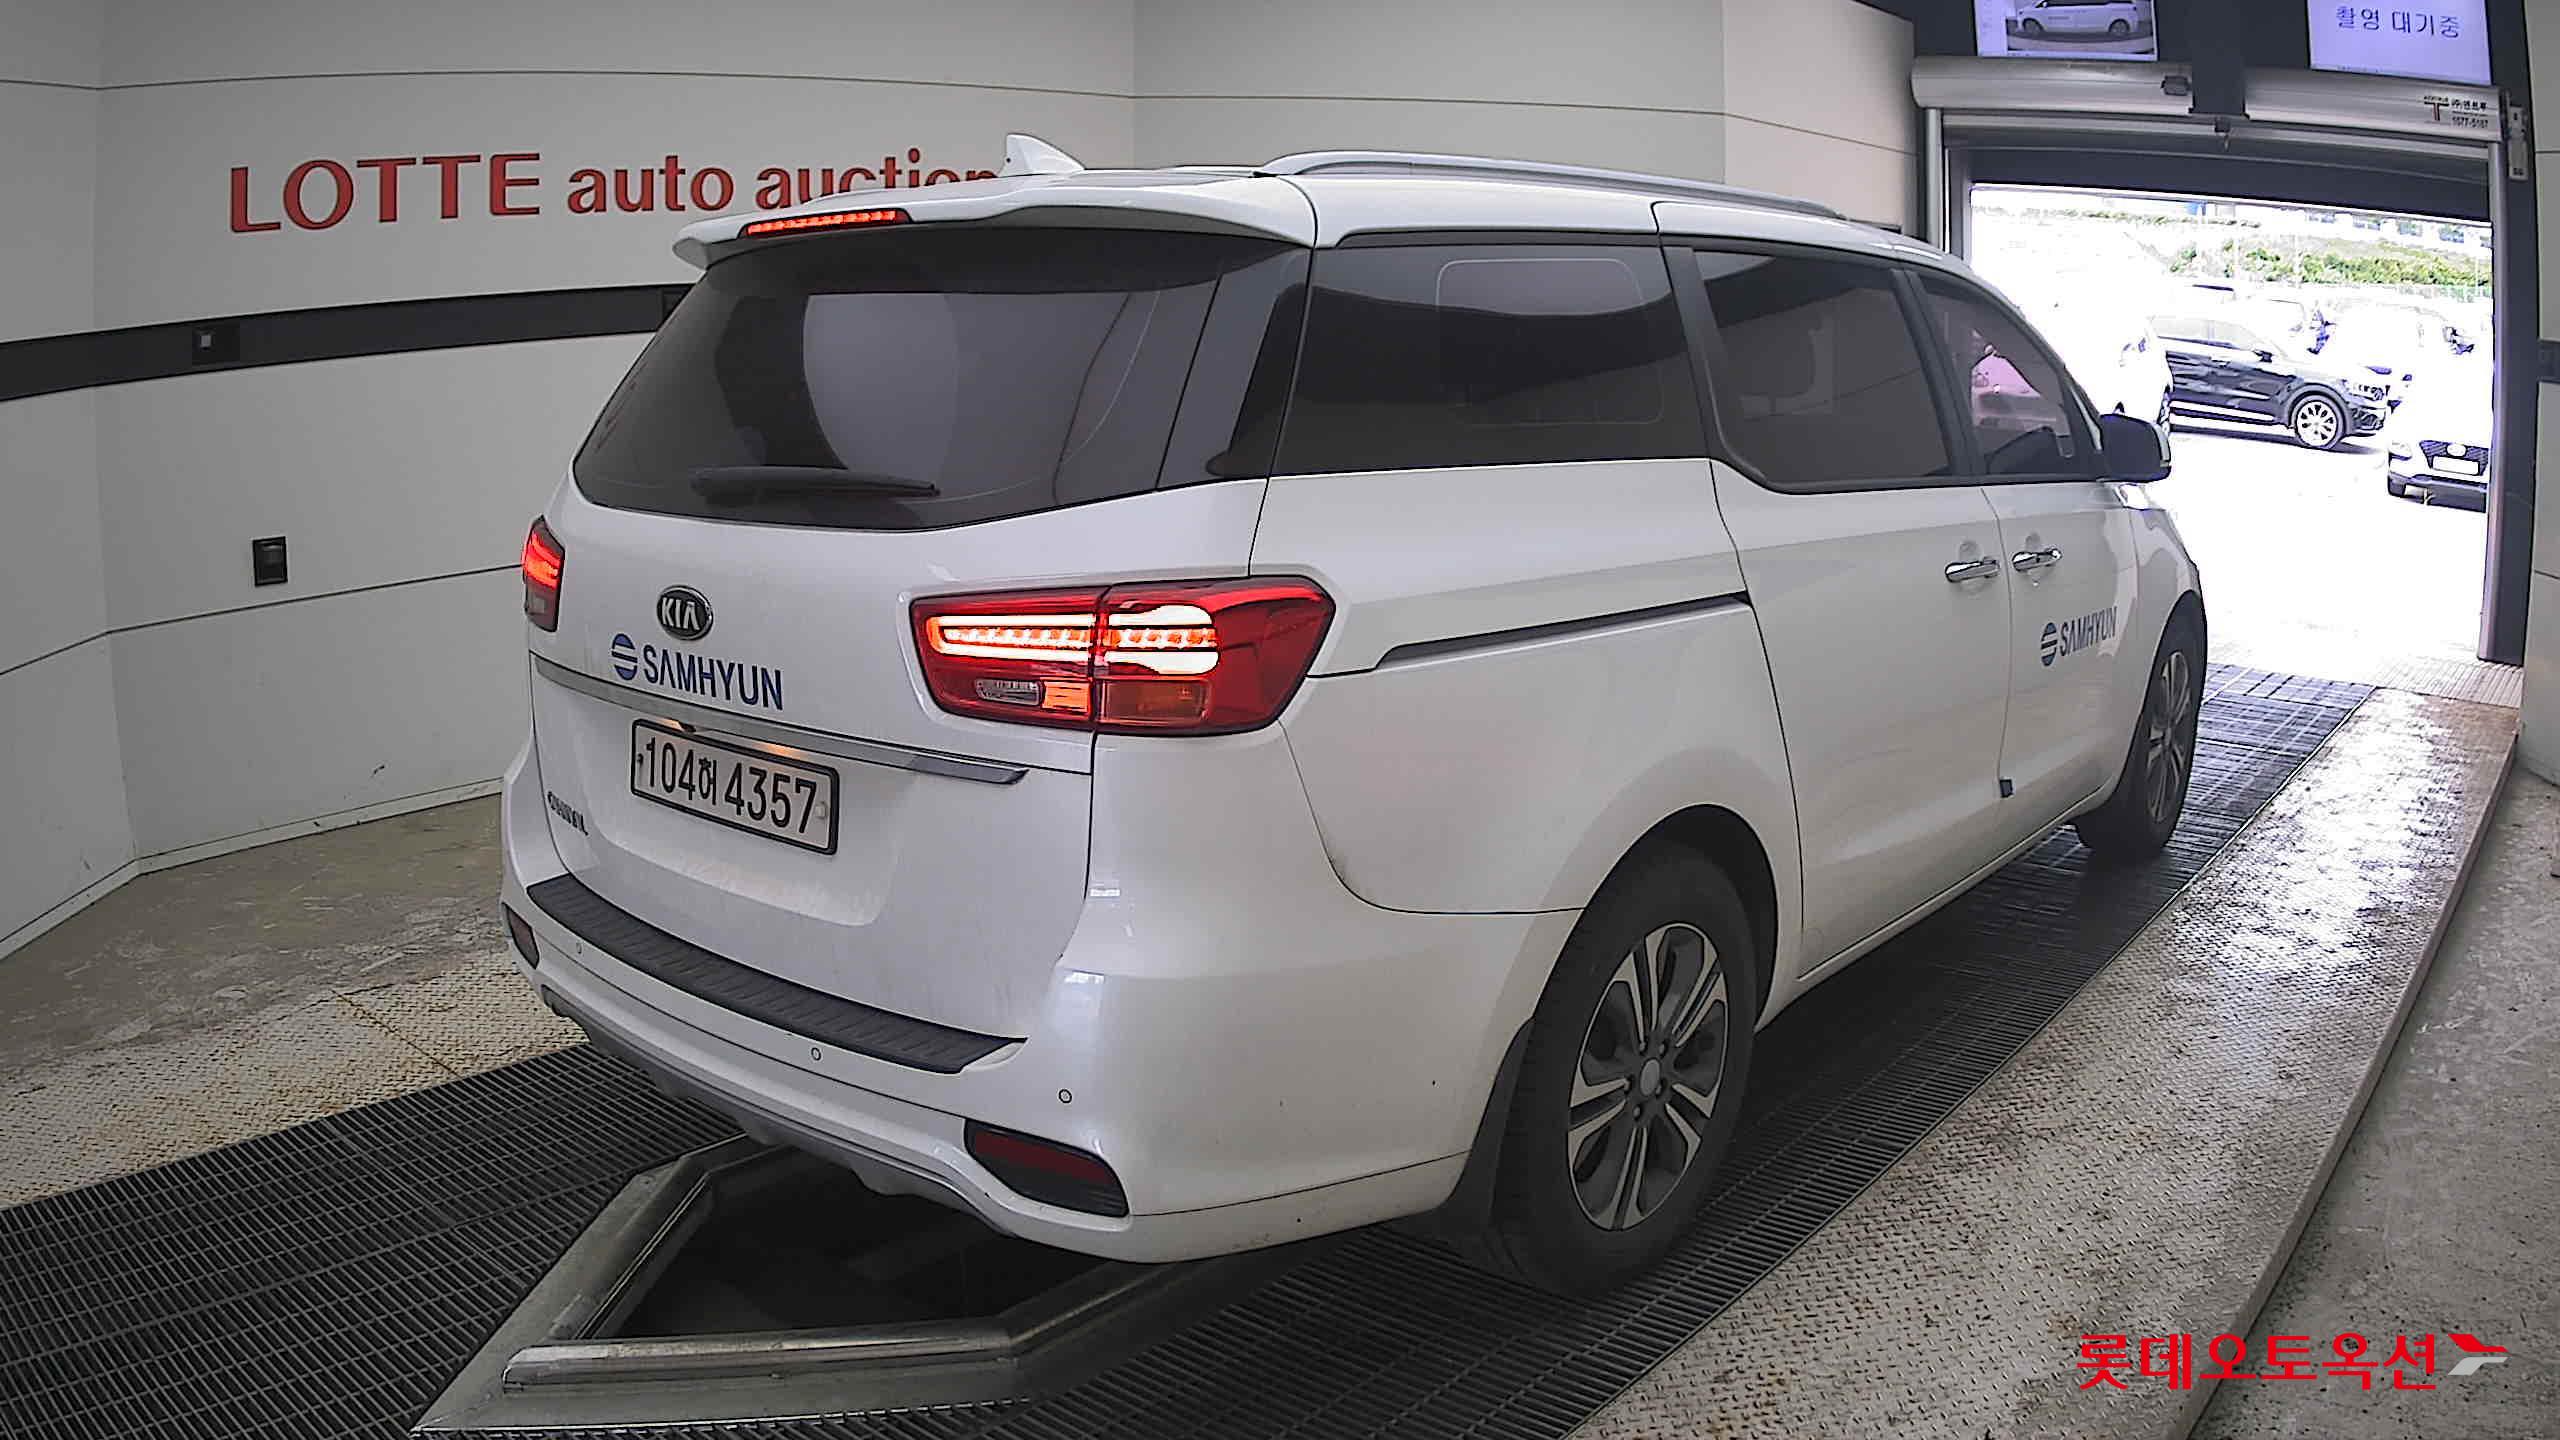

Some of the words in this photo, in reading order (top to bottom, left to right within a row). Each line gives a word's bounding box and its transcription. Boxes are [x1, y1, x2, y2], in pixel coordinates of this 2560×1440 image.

[2337, 7, 2379, 30] 촬영
[2392, 12, 2459, 38] 대기중
[231, 153, 540, 232] LOTTE
[567, 155, 734, 213] auto
[755, 147, 998, 209] aucti
[662, 597, 700, 631] KIA
[2060, 606, 2117, 657] SAMHYUN
[643, 645, 783, 711] SAMHYUN
[647, 737, 717, 805] 104허
[725, 762, 817, 834] 4357
